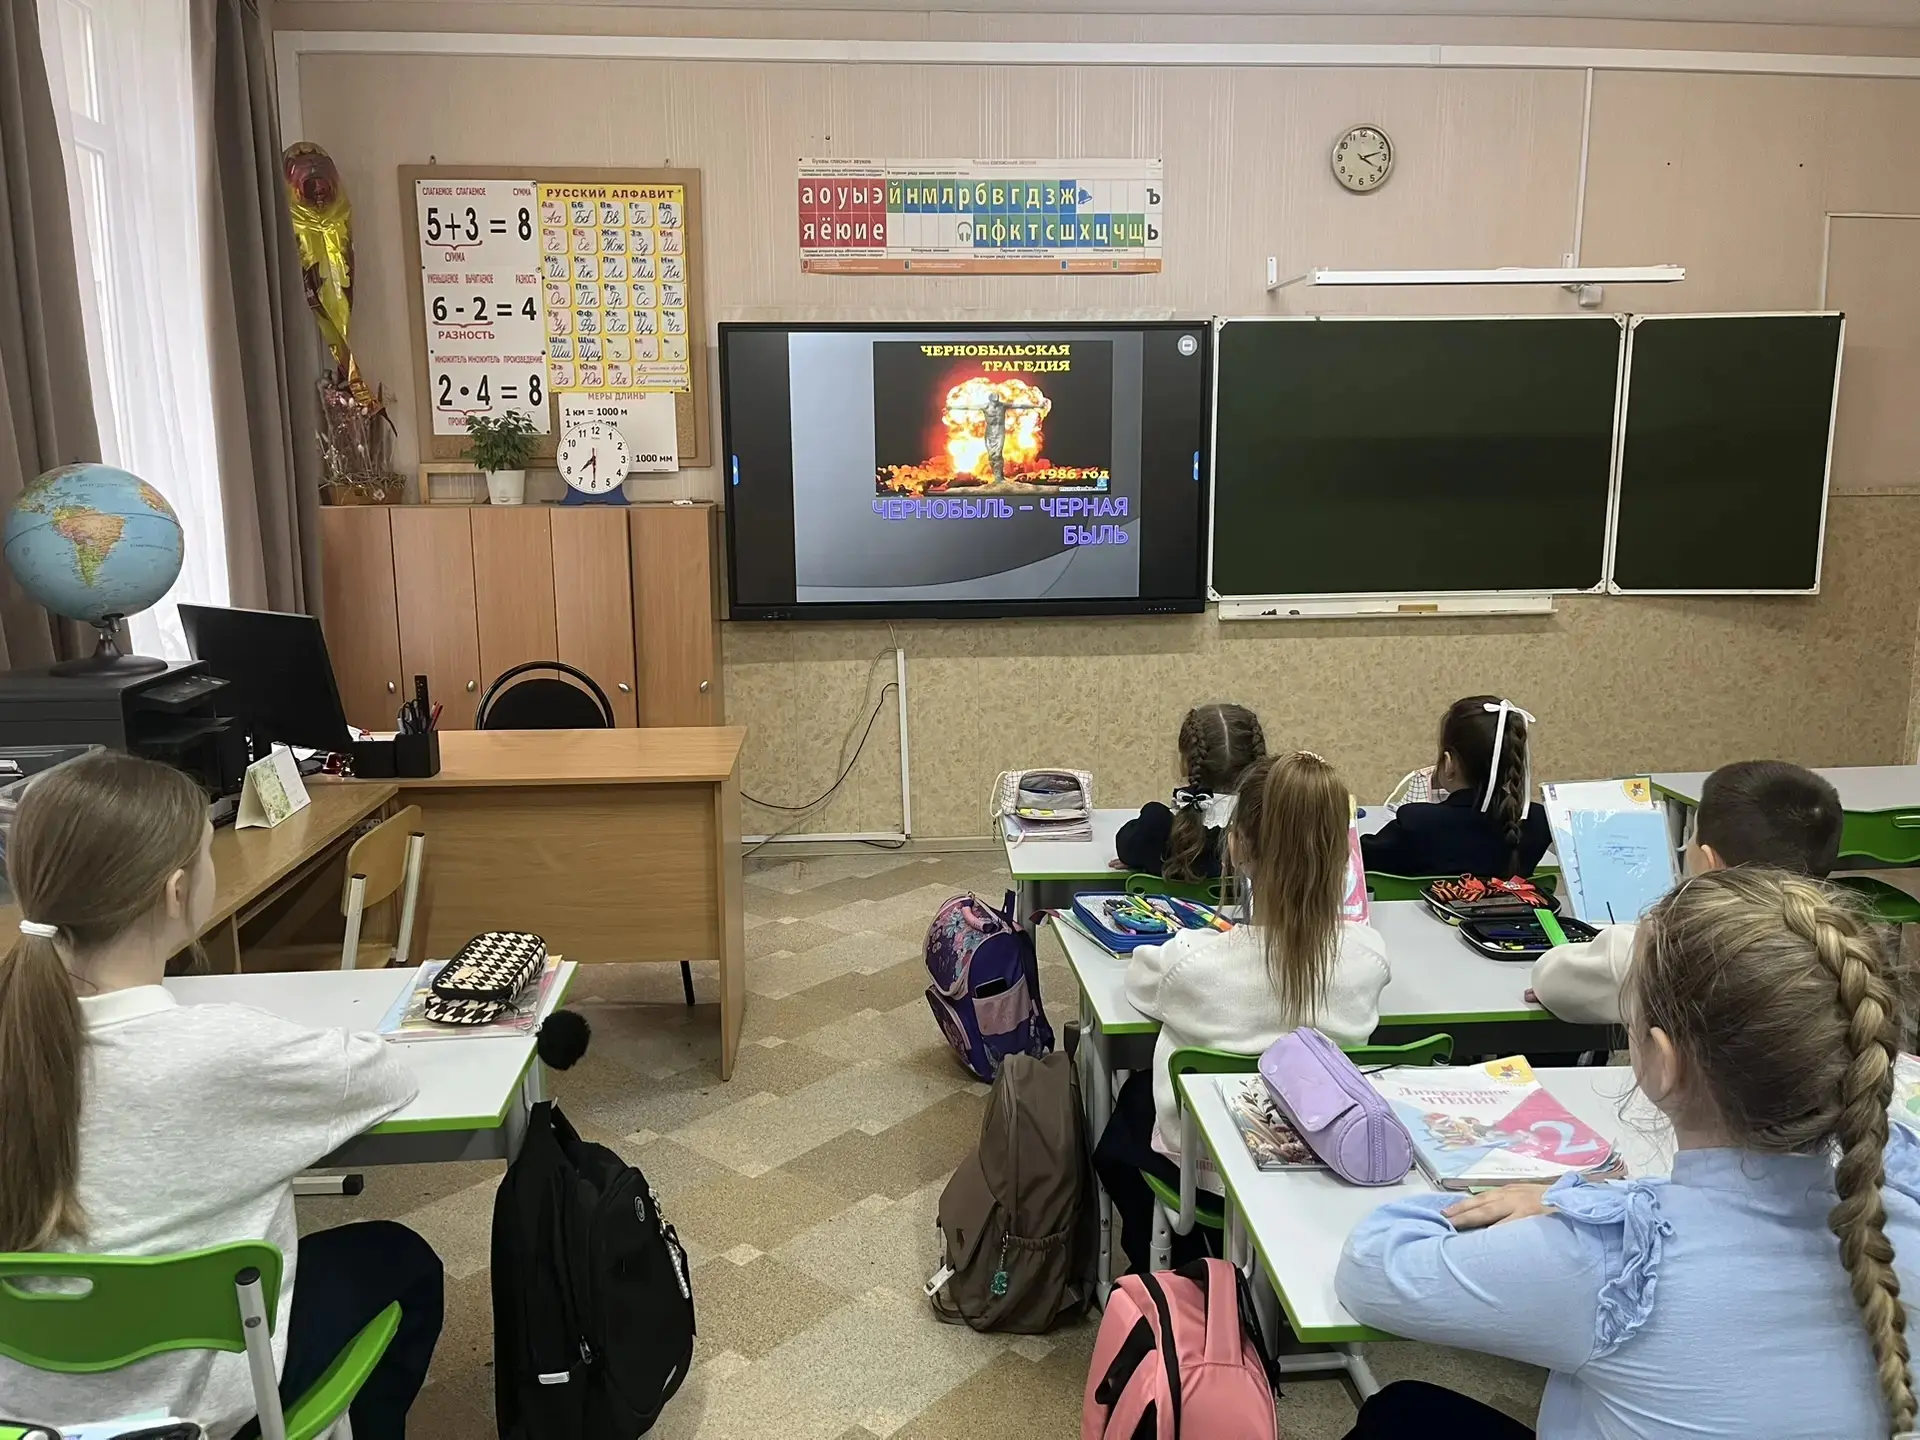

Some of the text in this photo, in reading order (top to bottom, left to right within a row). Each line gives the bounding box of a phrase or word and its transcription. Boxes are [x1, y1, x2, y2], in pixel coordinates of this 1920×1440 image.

[422, 187, 531, 196] СЛАГАЕМОЕ СЛАГАЕМОЕ СУММА
[546, 188, 674, 199] РУССКИЙ АЛФАВИТ
[889, 182, 1075, 210] й н м л р б в г д з ж
[802, 187, 883, 210] а о у ы э
[518, 207, 532, 241] 8
[803, 218, 884, 240] я ё ю и е
[976, 218, 1143, 246] п ф к т с ш х ц ч щ
[445, 252, 465, 262] СУММА
[432, 296, 447, 321] 6
[473, 296, 488, 320] 2
[522, 297, 536, 321] 4
[438, 331, 495, 340] РАЗНОСТЬ
[921, 345, 1070, 356] ЧЕРНОБЫЛЬСКАЯ
[982, 361, 1070, 372] ТРАГЕДИЯ
[439, 374, 452, 406] 2
[477, 374, 490, 405] 4
[529, 374, 542, 406] 8
[588, 392, 646, 401] МЕРЫ ДЛИНЫ
[565, 408, 570, 416] 1
[597, 408, 618, 416] 1000
[636, 454, 657, 462] 1000
[1040, 469, 1109, 480] 1986 год
[872, 499, 1014, 519] ЧЕРНОБЫЛЬ
[1040, 497, 1128, 517] ЧЕРНАЯ
[1063, 525, 1129, 544] БЫЛЬ
[1399, 1088, 1511, 1097] Литературное
[1530, 1121, 1599, 1156] 2
